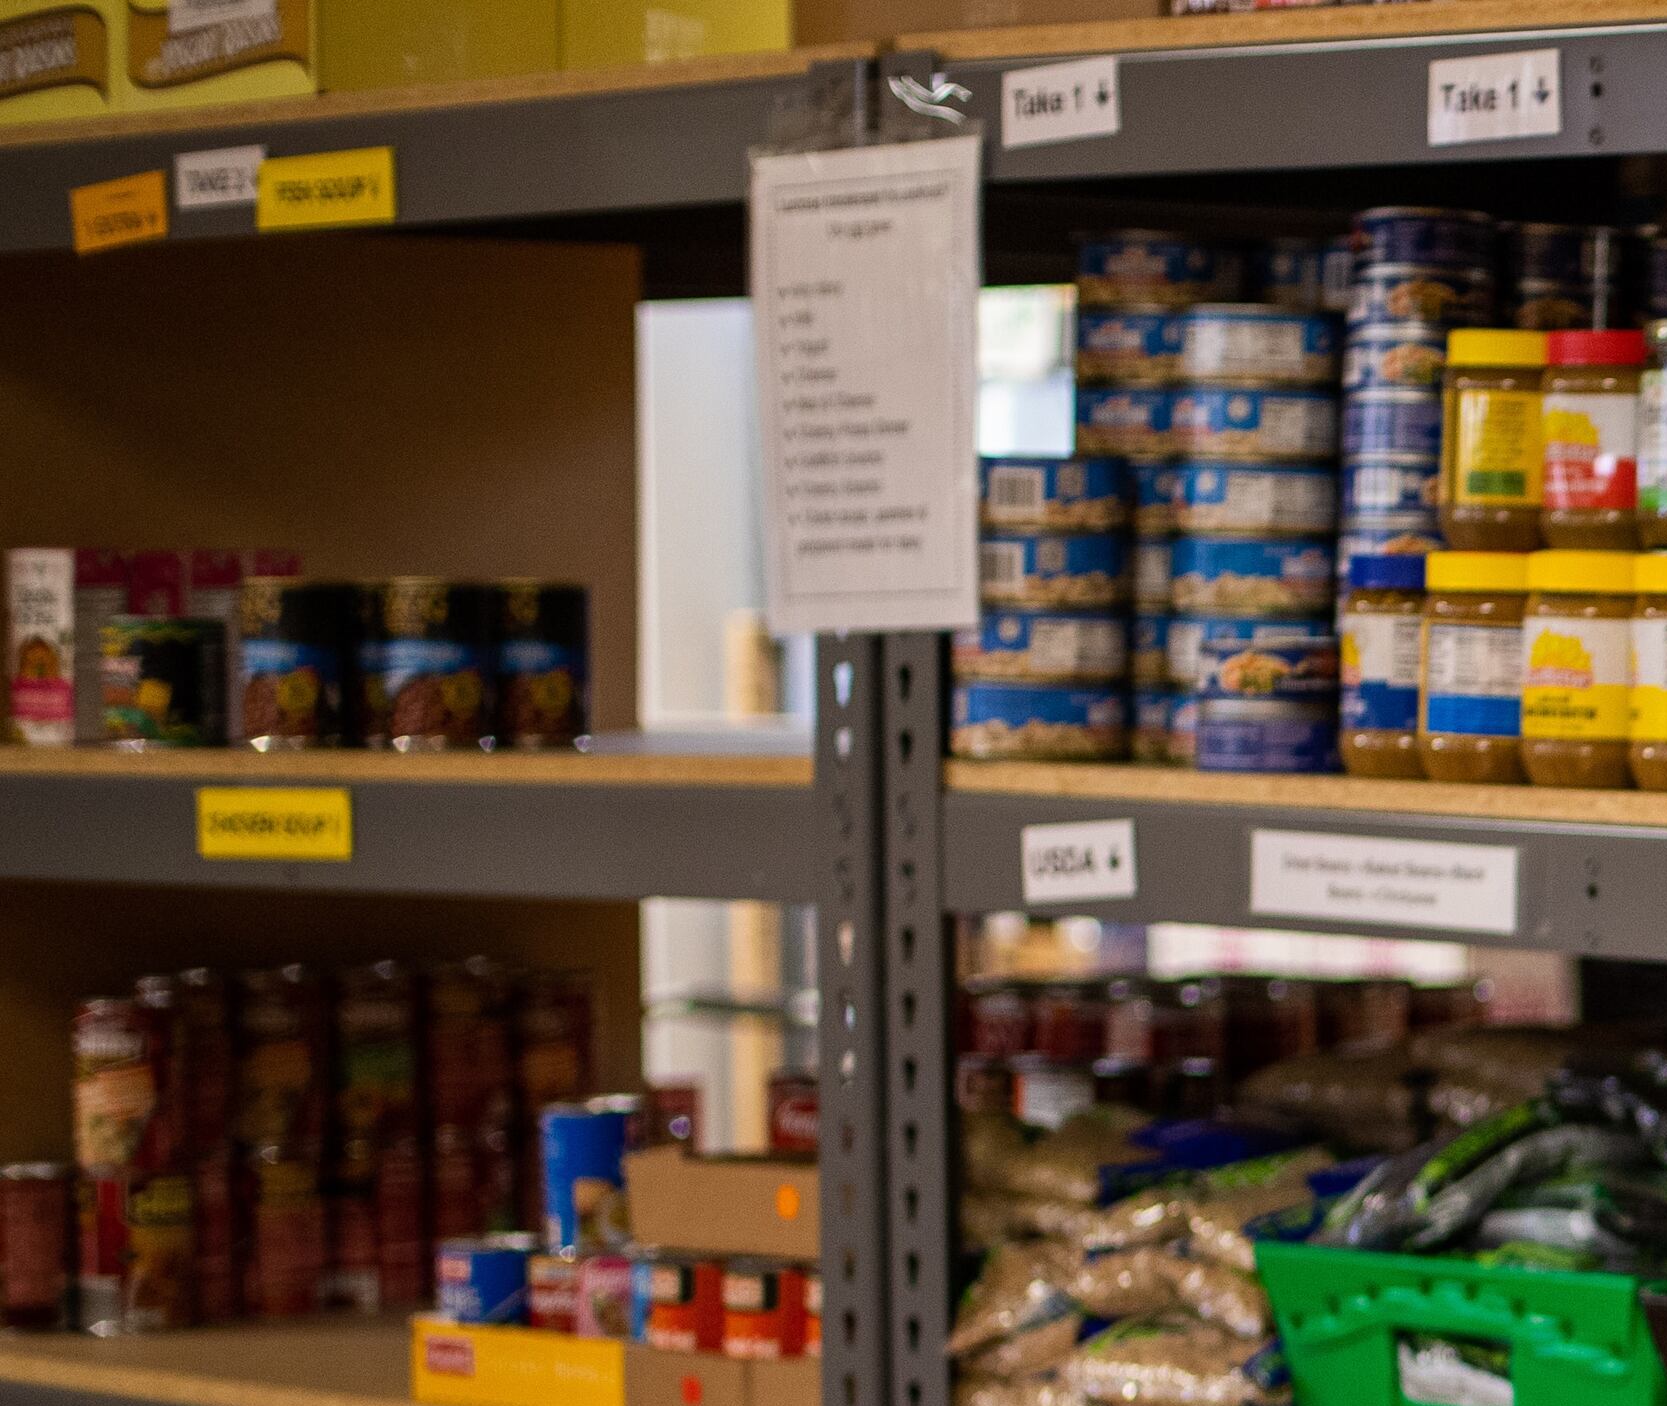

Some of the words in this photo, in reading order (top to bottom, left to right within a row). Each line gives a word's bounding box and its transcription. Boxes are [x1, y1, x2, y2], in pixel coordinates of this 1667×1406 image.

[1014, 85, 1063, 118] Take
[1074, 87, 1083, 113] 1
[1441, 81, 1498, 114] Take
[1509, 83, 1519, 111] 1
